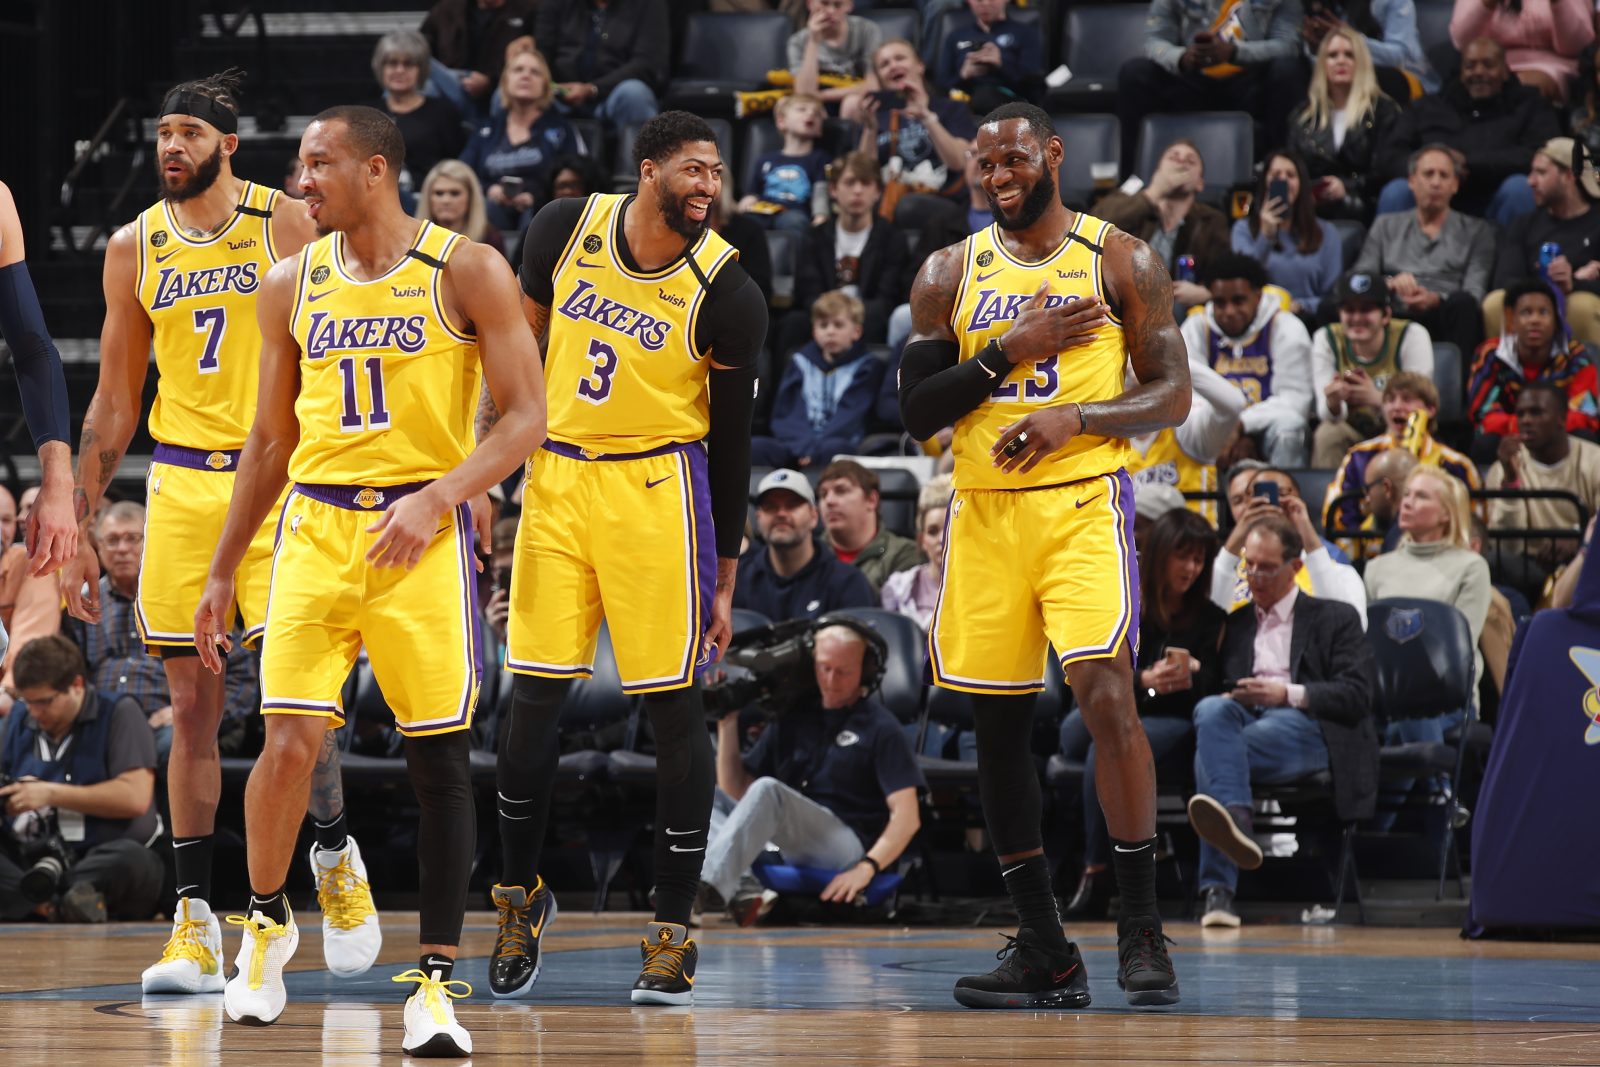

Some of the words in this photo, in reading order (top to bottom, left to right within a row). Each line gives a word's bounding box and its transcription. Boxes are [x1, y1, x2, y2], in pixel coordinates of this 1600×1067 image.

[227, 238, 257, 250] wish
[149, 262, 261, 311] LAKERS
[391, 286, 426, 297] wish
[658, 287, 687, 309] wish
[1056, 269, 1088, 279] wish
[192, 305, 228, 375] 7
[306, 310, 429, 361] LAKERS
[556, 278, 673, 352] LAKERS
[337, 355, 392, 434] 11
[575, 336, 619, 407] 3
